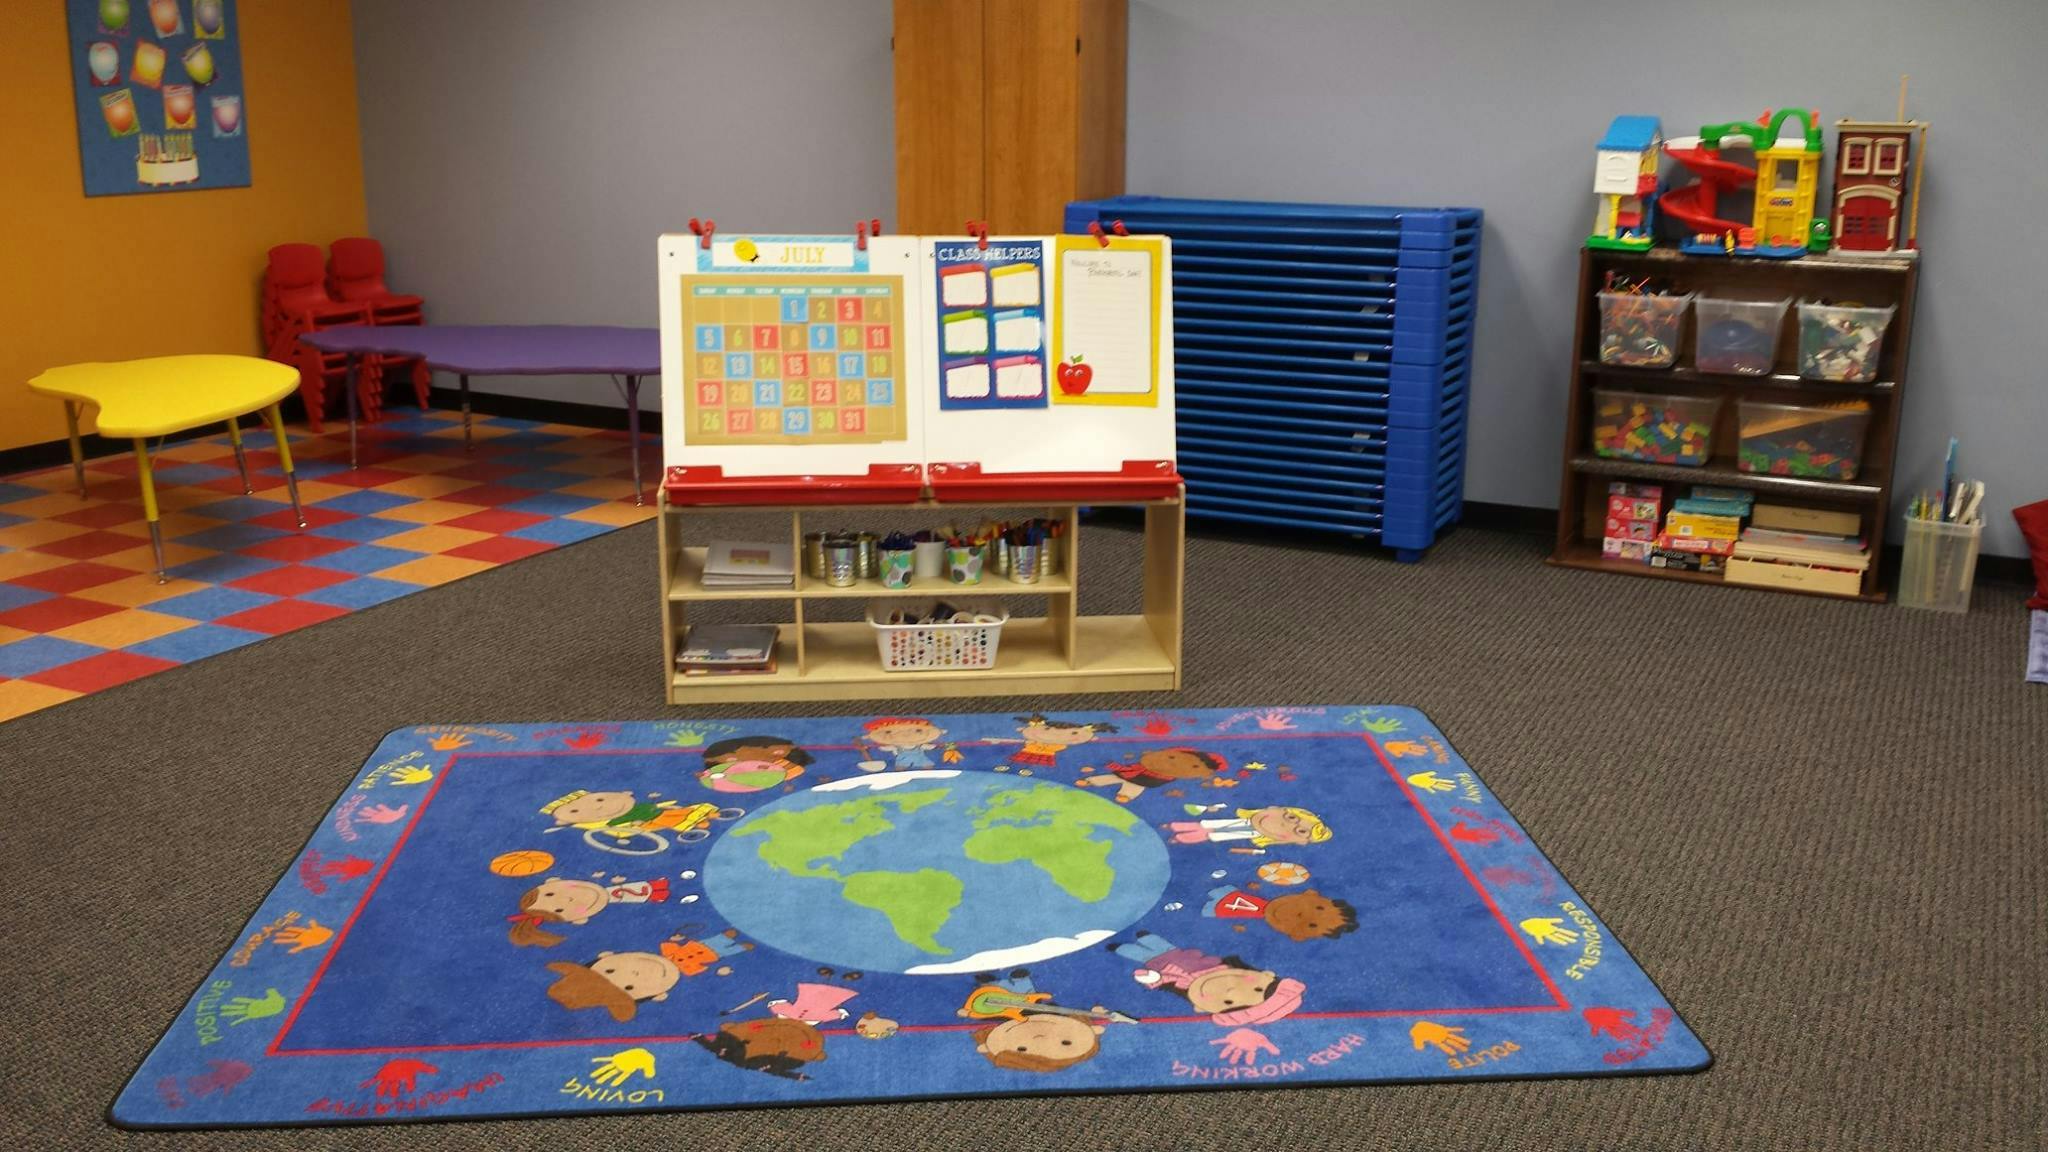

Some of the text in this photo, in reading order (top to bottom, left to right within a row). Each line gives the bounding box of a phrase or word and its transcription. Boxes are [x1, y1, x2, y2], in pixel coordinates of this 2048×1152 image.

[780, 246, 826, 264] JULY
[938, 246, 1041, 261] CLASS HELPERS
[790, 300, 882, 318] 1 2 3 4
[704, 328, 885, 346] 5 6 7 8 9 10 11
[703, 356, 887, 374] 12 13 14 15 16 17 18
[703, 386, 718, 403] 19
[731, 386, 748, 402] 20
[760, 385, 775, 401] 21
[788, 385, 805, 401] 22
[816, 384, 833, 401] 23
[846, 385, 862, 401] 24
[703, 411, 860, 430] 26 27 28 29 30 31
[653, 721, 742, 734] HONESTY
[357, 750, 424, 789] PATIENCE
[1454, 772, 1482, 803] FUNNY
[611, 884, 650, 900] 2
[1223, 897, 1258, 913] 4
[230, 910, 301, 967] COURAGE
[1559, 901, 1602, 981] RESPONSIBLE
[195, 979, 233, 1046] POSITIVE
[1172, 1031, 1368, 1079] HARD WORKING
[1448, 1040, 1522, 1070] POLITE
[559, 1078, 664, 1103] LOVING
